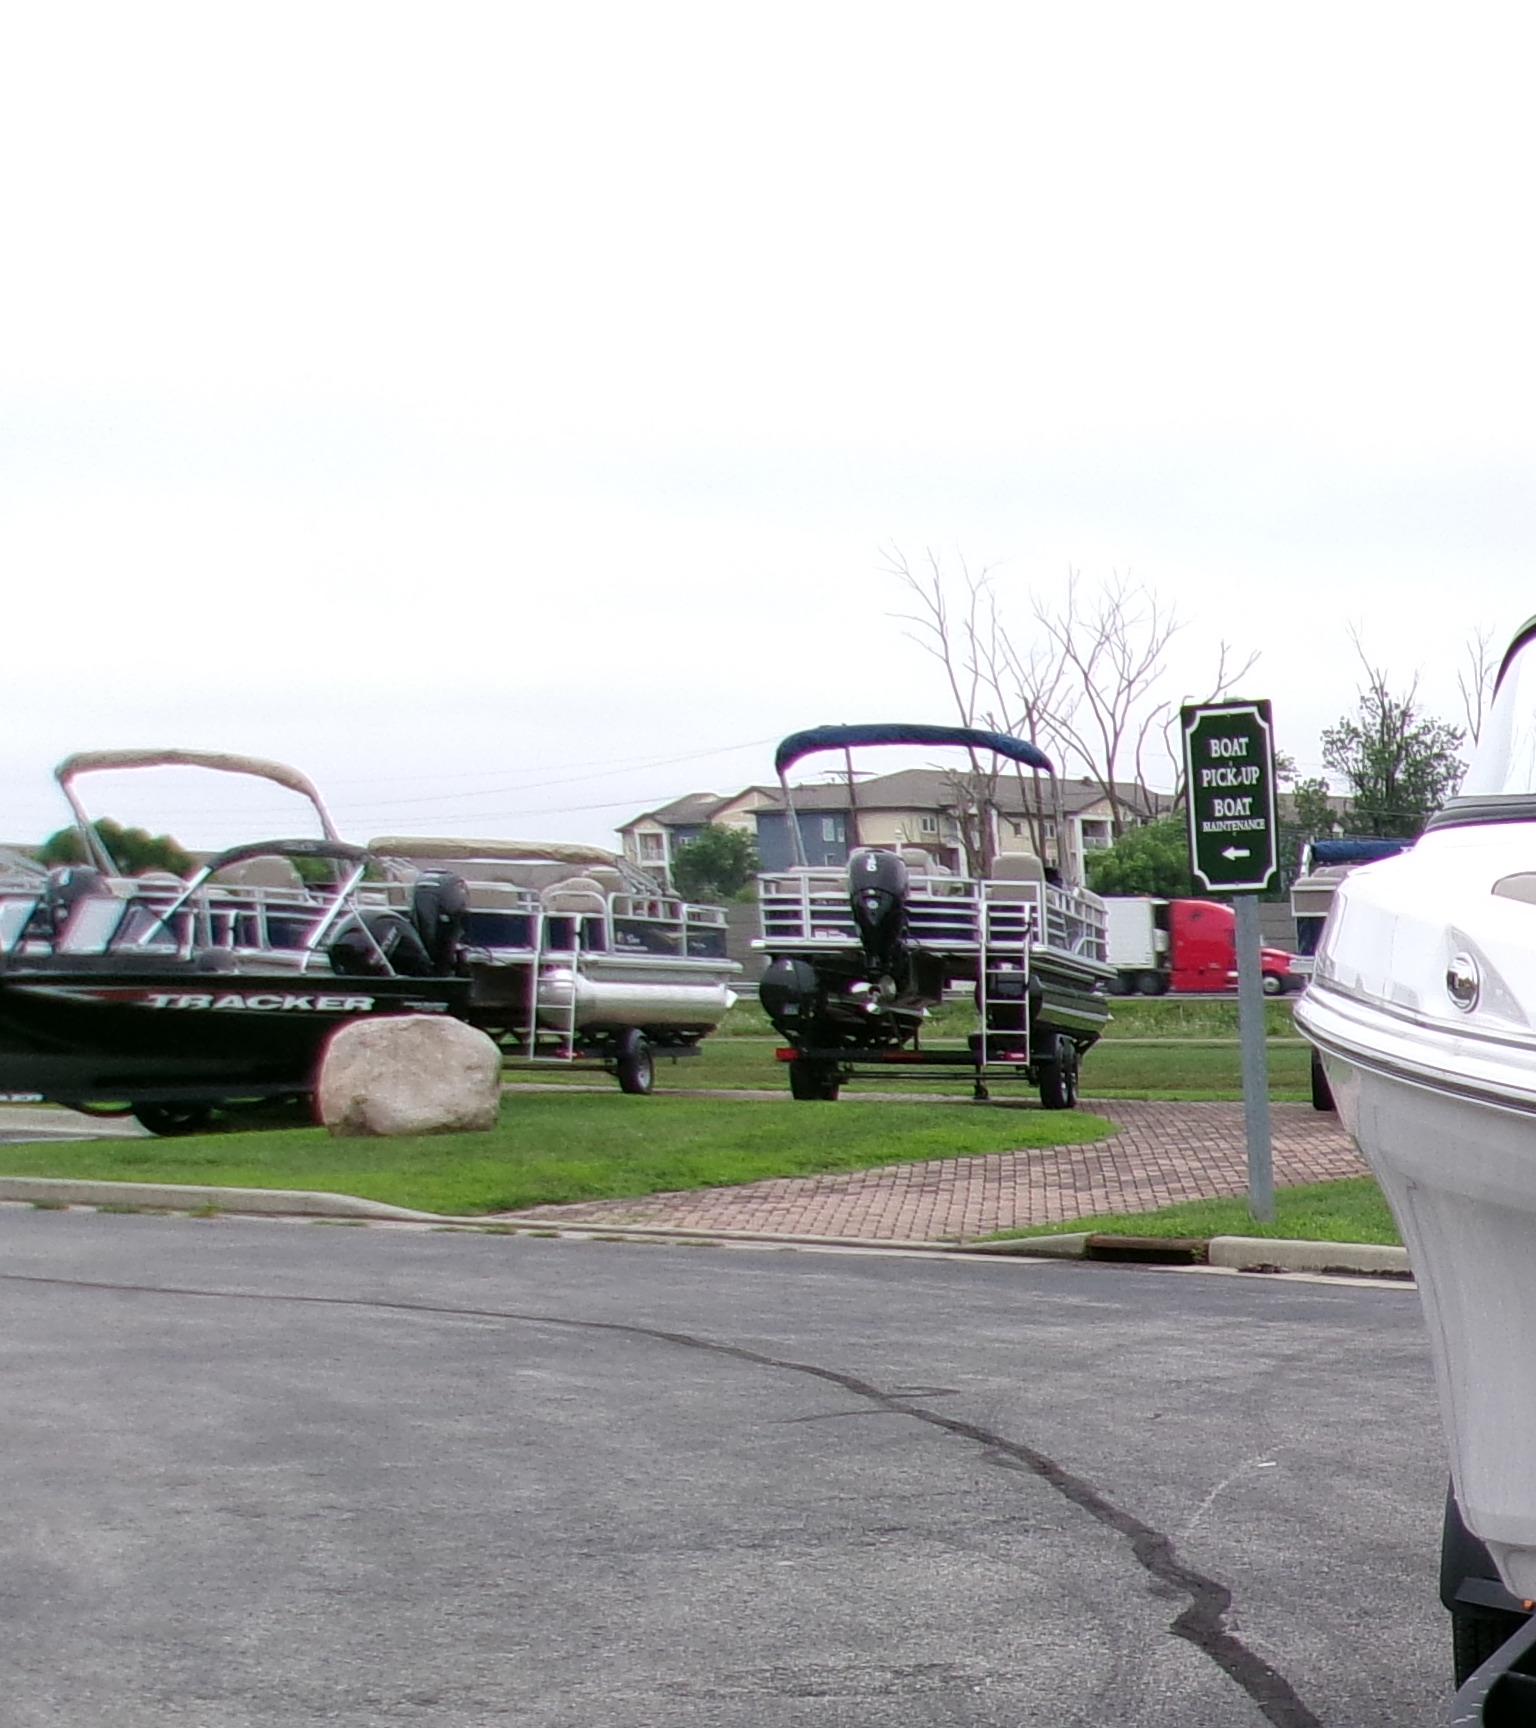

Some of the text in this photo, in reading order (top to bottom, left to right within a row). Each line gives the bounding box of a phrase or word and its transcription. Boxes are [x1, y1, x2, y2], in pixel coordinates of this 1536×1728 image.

[1210, 737, 1249, 758] BOAT
[1213, 797, 1253, 817] BOAT
[1202, 818, 1266, 832] MAINTENANCE
[149, 994, 376, 1011] TRACKER
